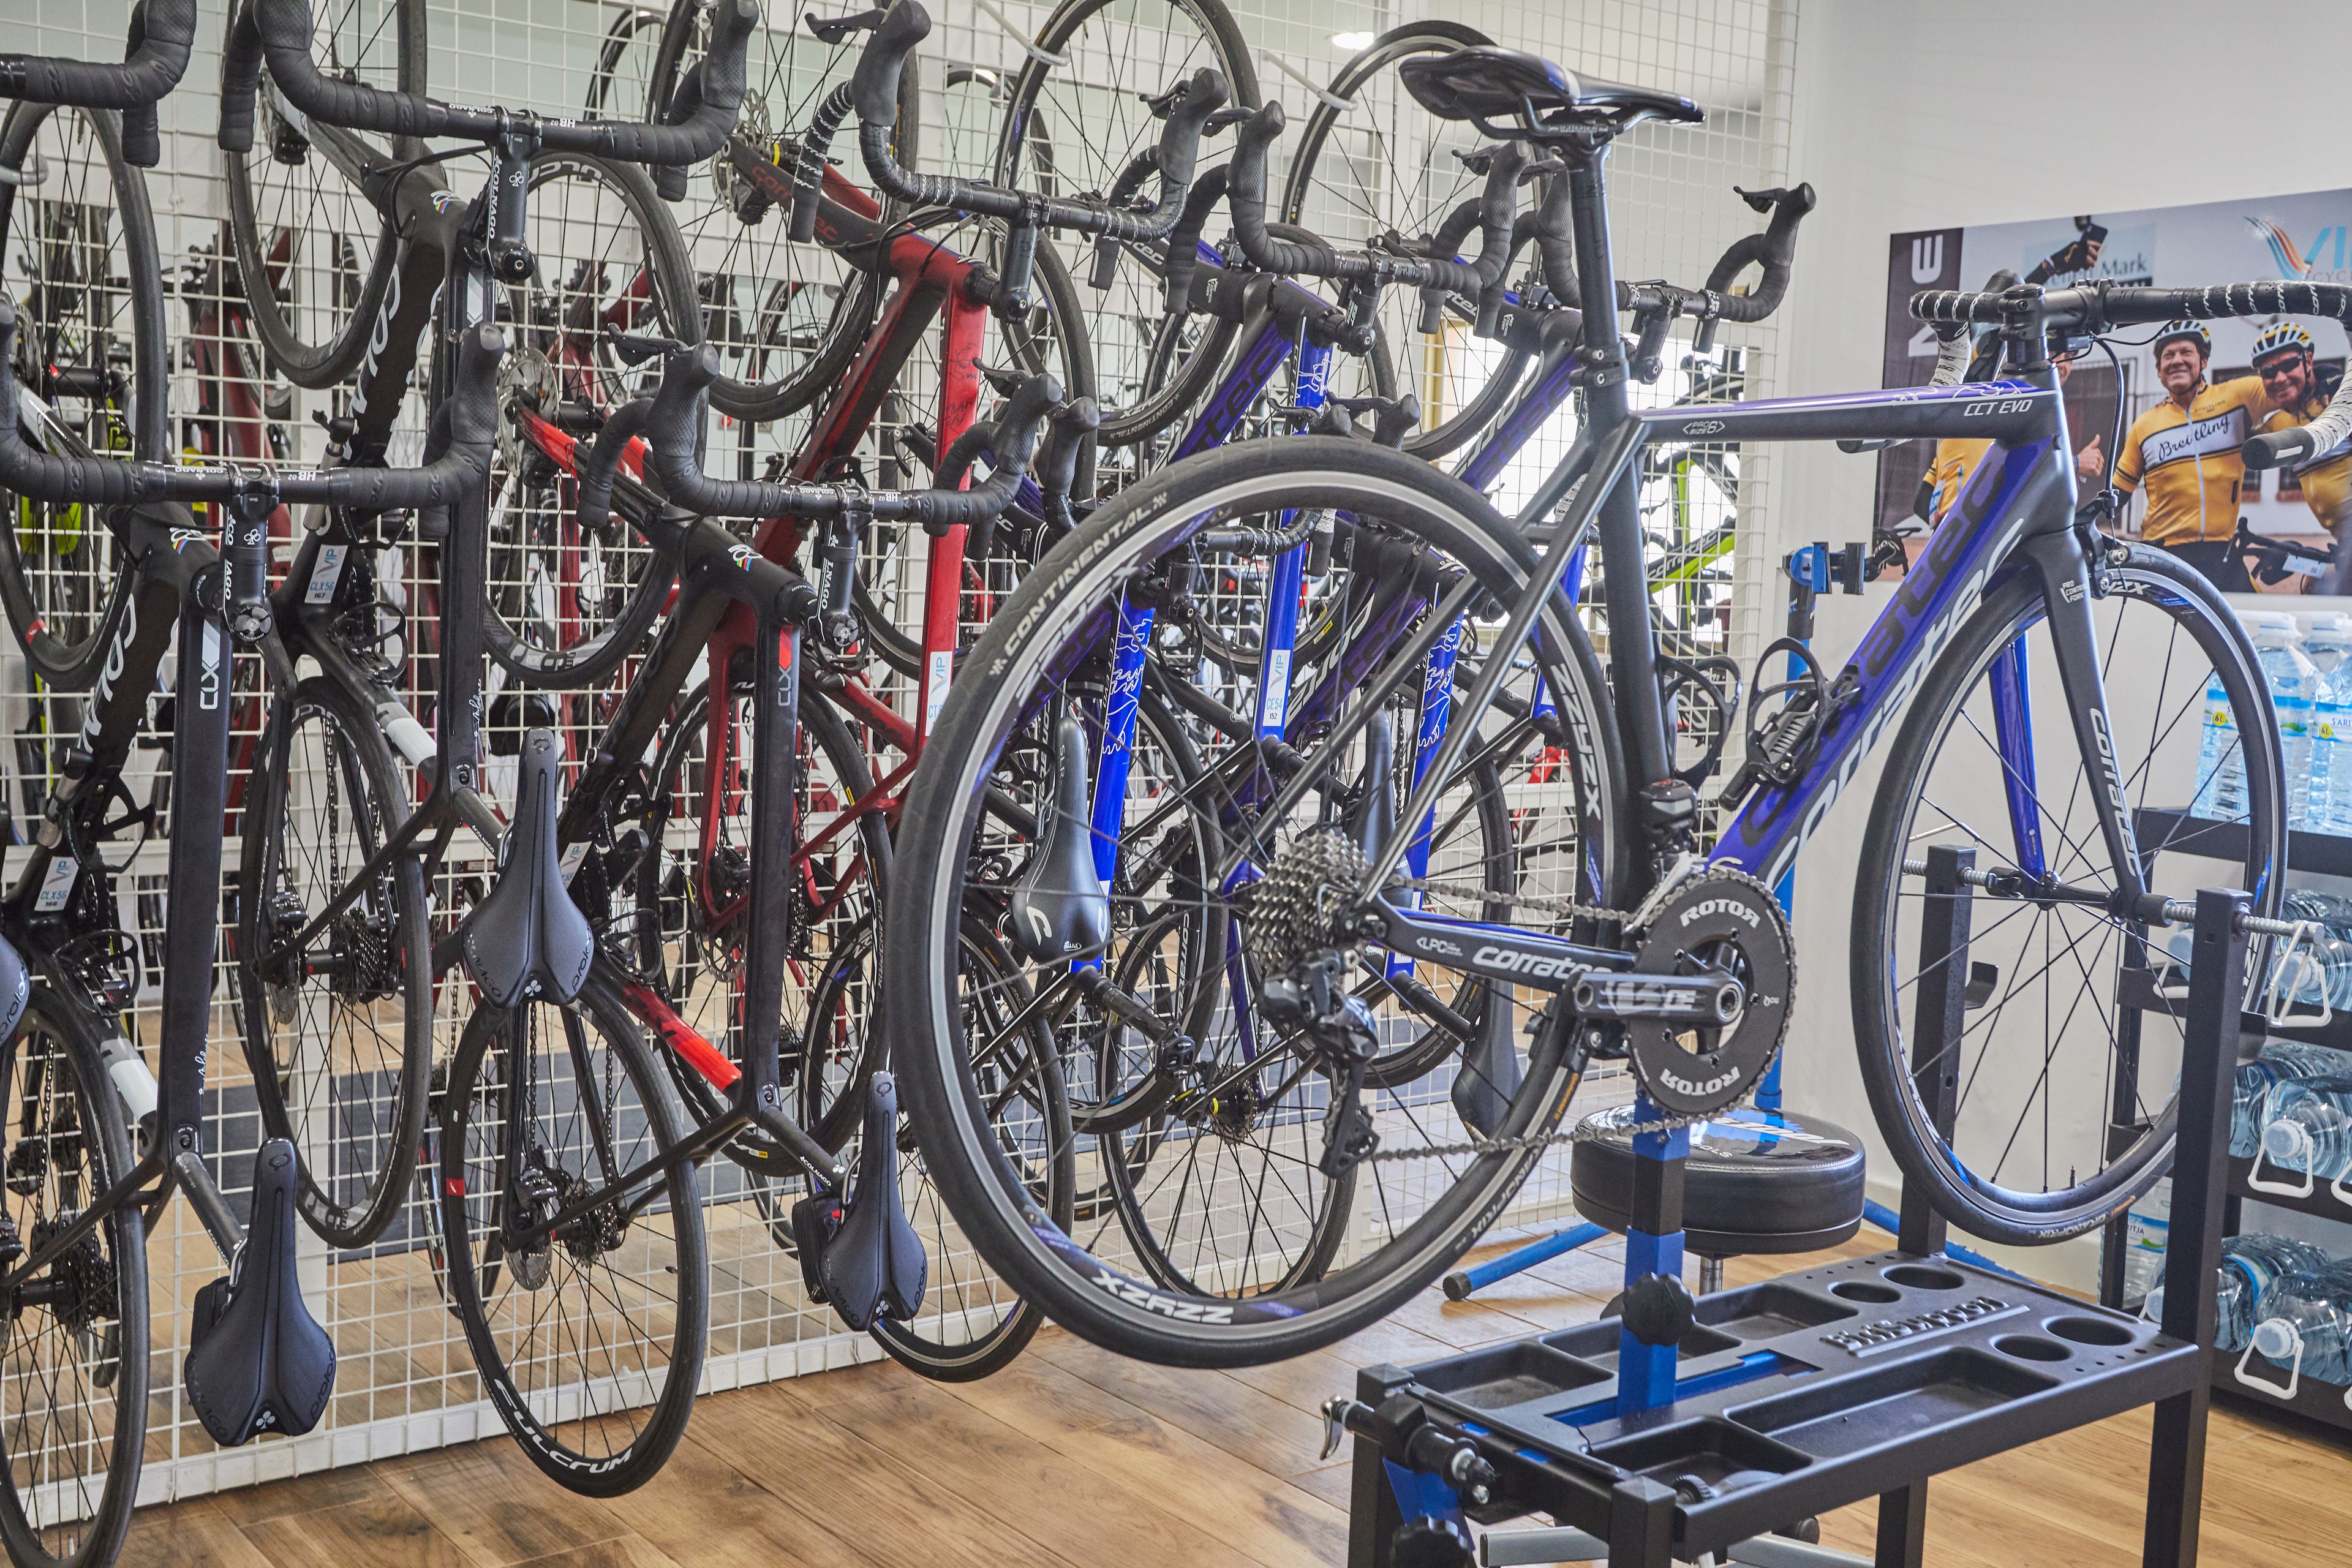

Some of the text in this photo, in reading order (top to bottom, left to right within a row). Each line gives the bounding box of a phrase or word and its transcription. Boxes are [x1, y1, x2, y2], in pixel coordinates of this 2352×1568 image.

[489, 164, 500, 239] COLNAGO
[2101, 252, 2147, 276] Mark
[1964, 399, 2034, 417] CCT EVO
[2158, 415, 2230, 462] Breitling
[298, 471, 315, 481] HB
[1003, 506, 1153, 658] CONTINENTAL
[2062, 580, 2075, 590] PRO
[2069, 592, 2086, 603] FORK
[1550, 663, 1601, 821] ZZYZX
[2090, 707, 2141, 877] corratec
[1679, 898, 1760, 929] ROTOR
[1659, 1066, 1741, 1096] ROTOR
[803, 1159, 832, 1187] COLNAGO
[1092, 1267, 1234, 1325] ZZYZX
